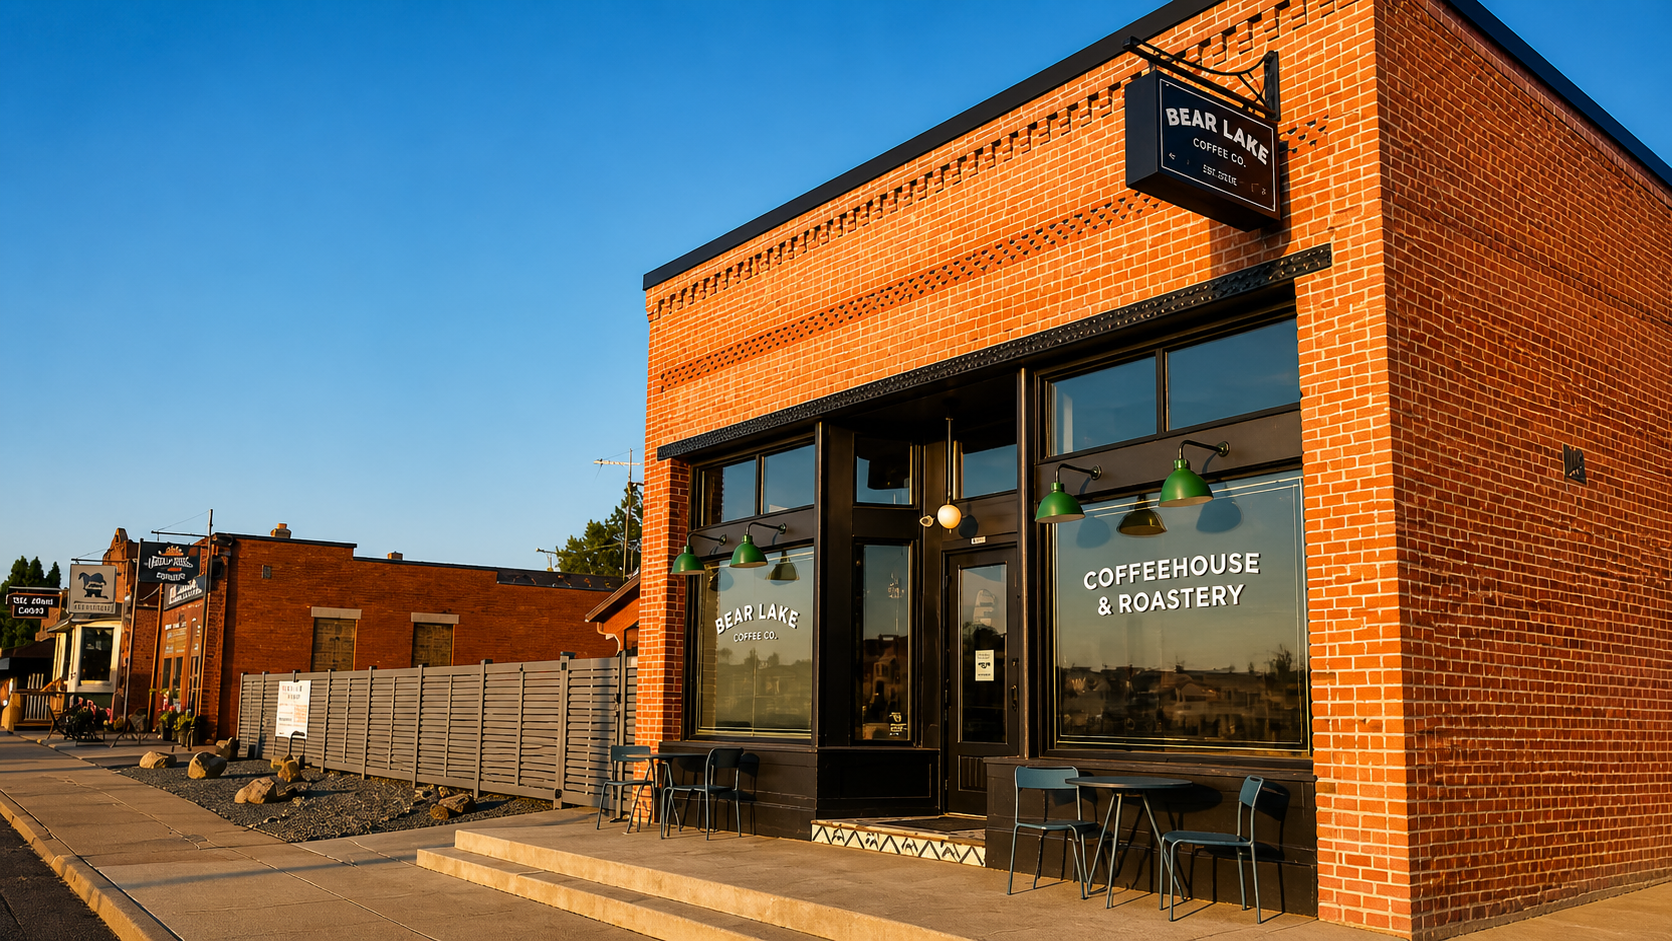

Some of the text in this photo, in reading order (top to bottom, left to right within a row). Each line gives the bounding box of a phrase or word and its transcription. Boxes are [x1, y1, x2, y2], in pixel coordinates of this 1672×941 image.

[1165, 108, 1269, 165] BEAR LAKE
[1193, 138, 1228, 159] COFFEE
[1231, 153, 1247, 168] CO.
[1083, 552, 1260, 590] COFFEEHOUSE
[1097, 584, 1245, 616] & ROASTERY
[715, 603, 799, 635] BEAR LAKE
[733, 631, 778, 642] COFFEE CO.
